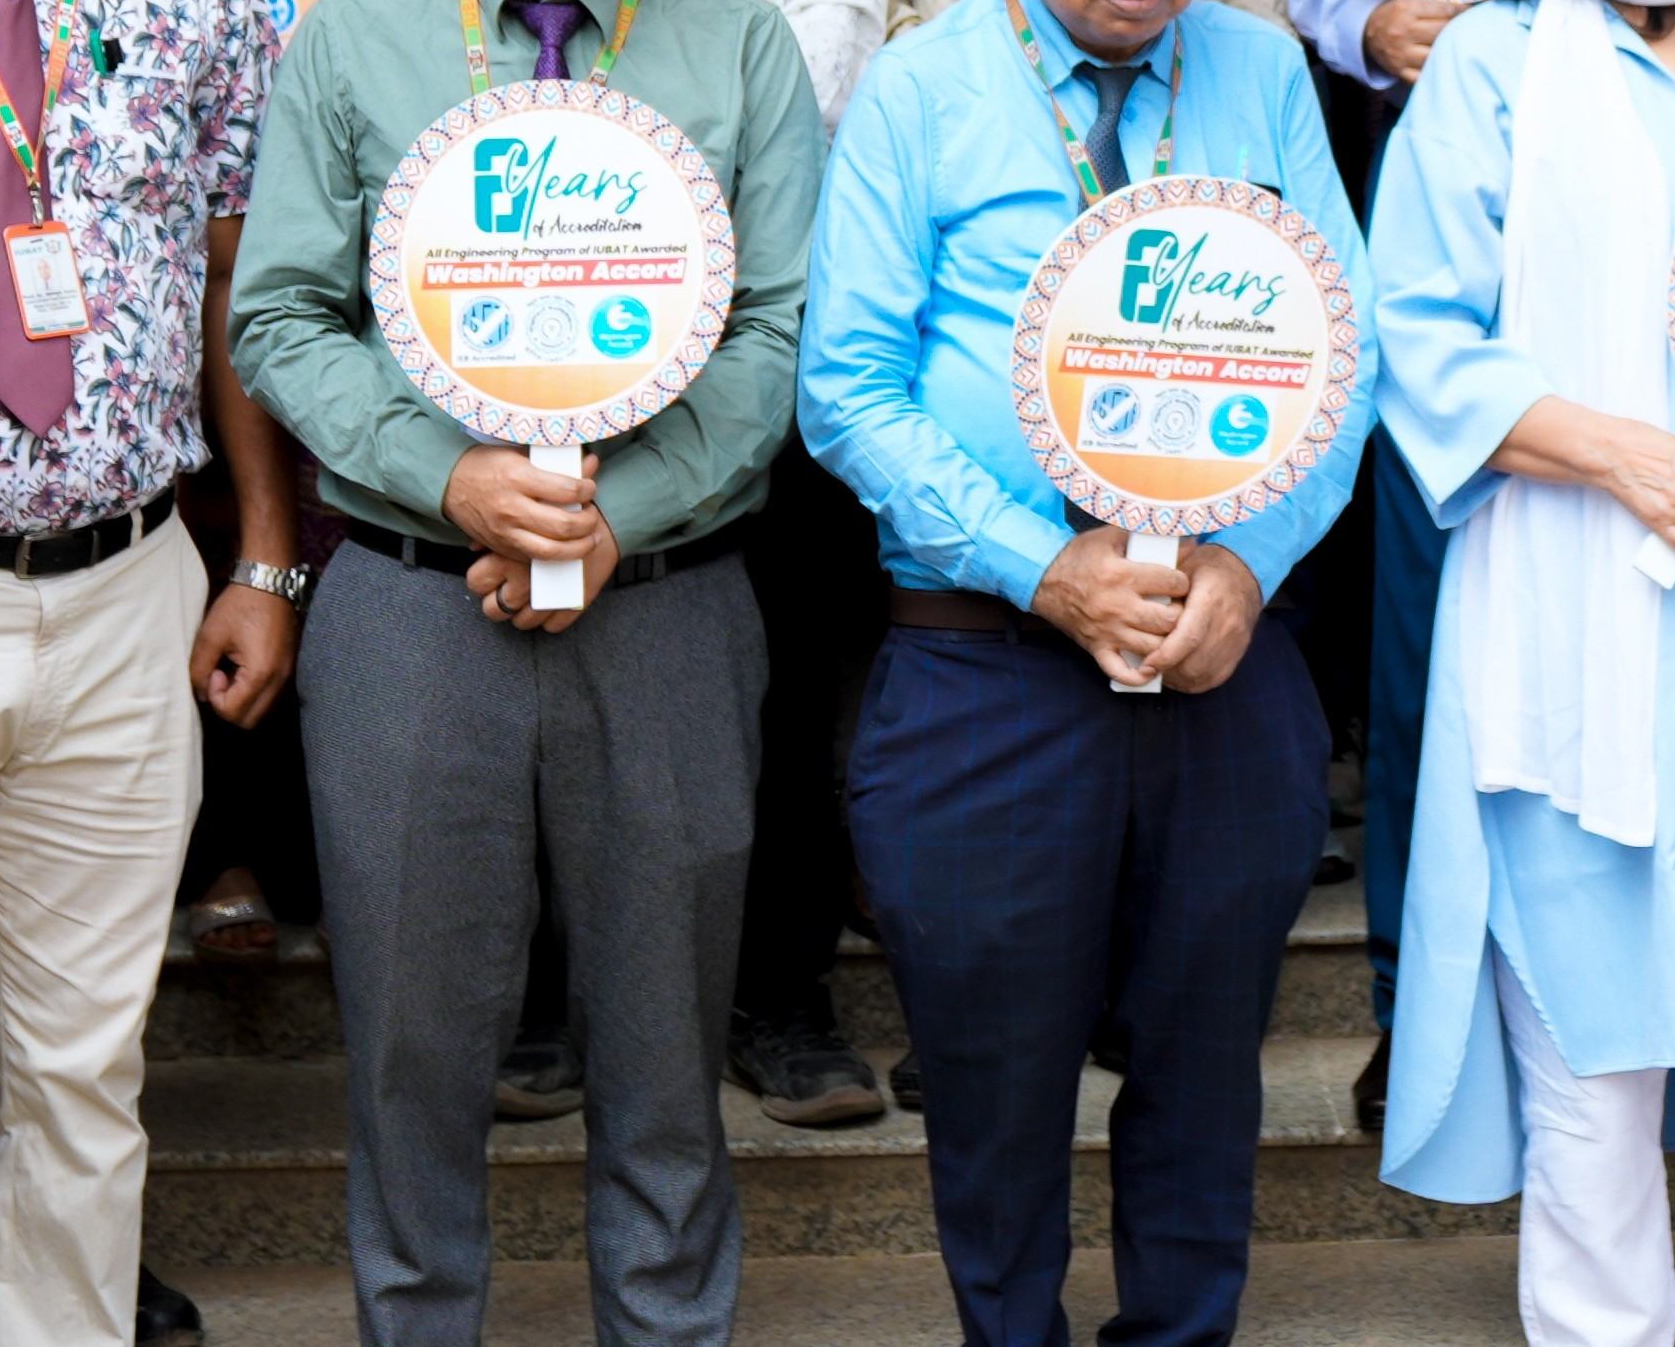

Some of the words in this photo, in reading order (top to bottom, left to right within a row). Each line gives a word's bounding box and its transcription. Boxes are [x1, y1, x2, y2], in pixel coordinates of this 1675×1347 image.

[506, 135, 647, 240] Years
[533, 219, 545, 238] of
[549, 214, 643, 235] Accreditation
[426, 248, 442, 258] All
[444, 246, 519, 261] Engineering
[522, 247, 576, 260] Program
[579, 245, 591, 255] of
[593, 245, 628, 255] IUBAT
[632, 244, 687, 254] Awarded
[425, 261, 584, 287] Washington
[591, 259, 685, 281] Accord
[1153, 233, 1285, 333] Years
[1172, 314, 1185, 332] of
[1188, 310, 1275, 334] Accreditation
[1067, 333, 1083, 343] All
[1085, 334, 1155, 351] Engineering
[1158, 339, 1209, 353] Program
[1211, 341, 1223, 352] of
[1225, 344, 1259, 355] IUBAT
[1262, 346, 1314, 359] Awarded
[1064, 348, 1214, 379] Washington
[1219, 360, 1309, 384] Accord
